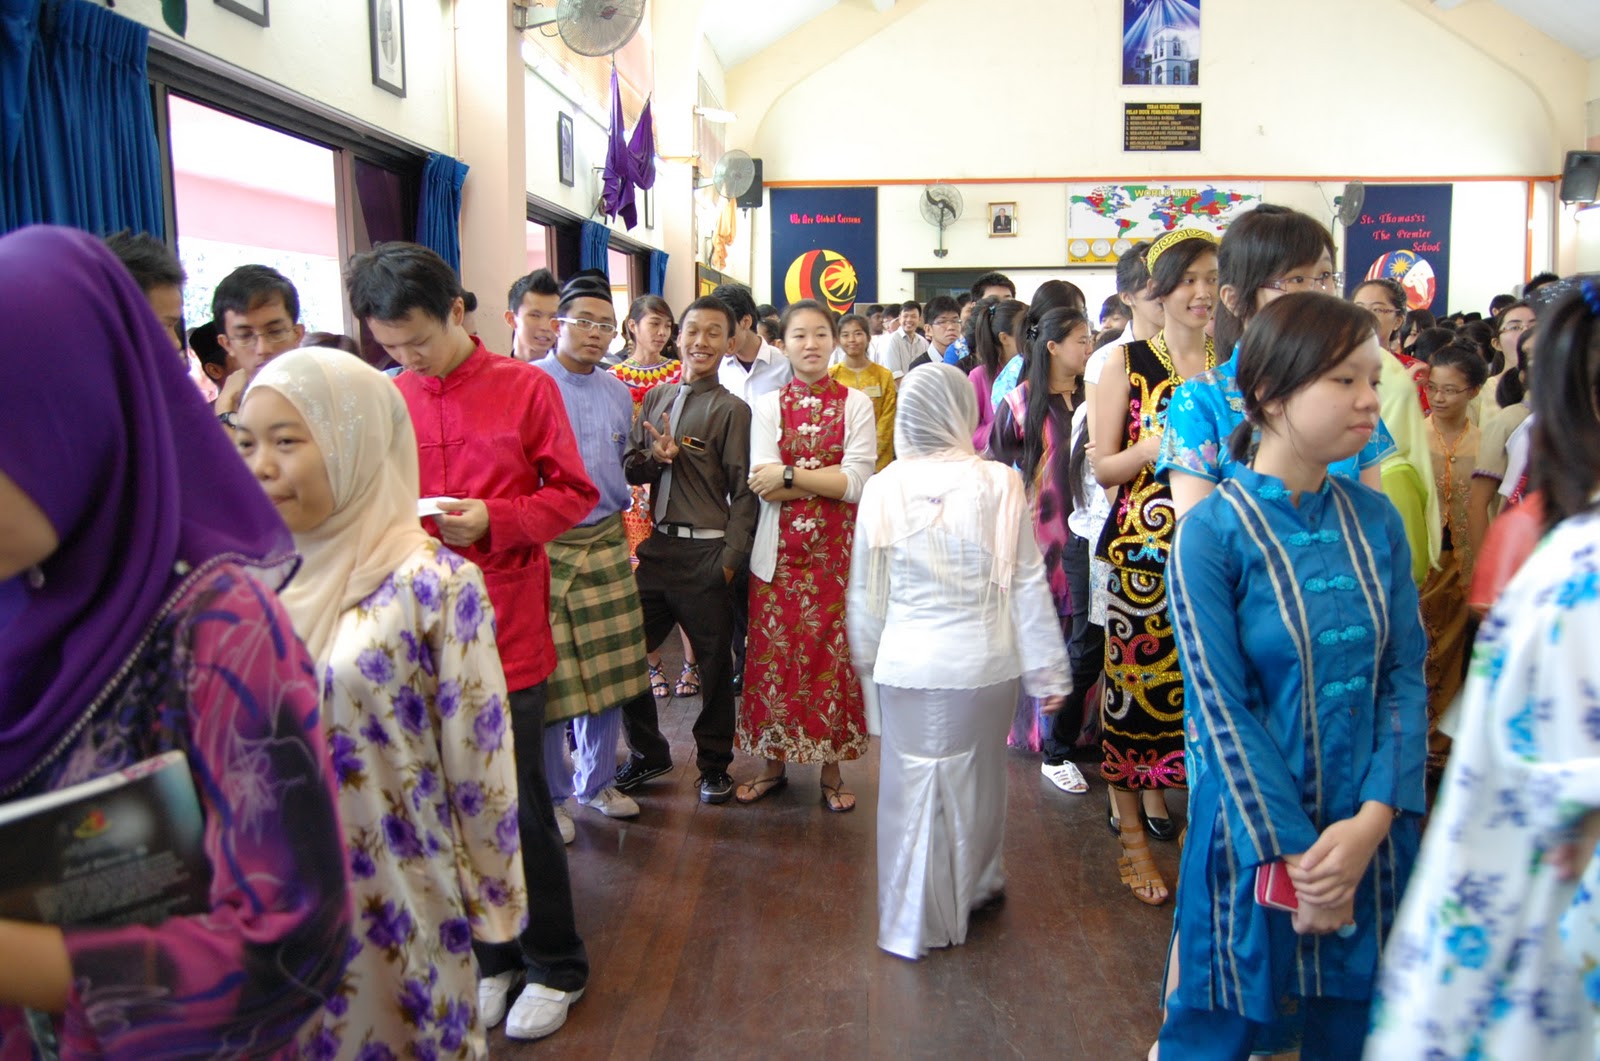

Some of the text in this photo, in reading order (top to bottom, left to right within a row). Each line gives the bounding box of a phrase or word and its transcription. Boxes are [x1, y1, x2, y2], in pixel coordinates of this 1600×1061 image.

[1134, 188, 1197, 198] WORLD TIME
[790, 213, 800, 224] We
[816, 213, 836, 224] Global
[1360, 214, 1374, 224] St.
[1372, 228, 1432, 240] The Premier
[1412, 241, 1441, 252] School
